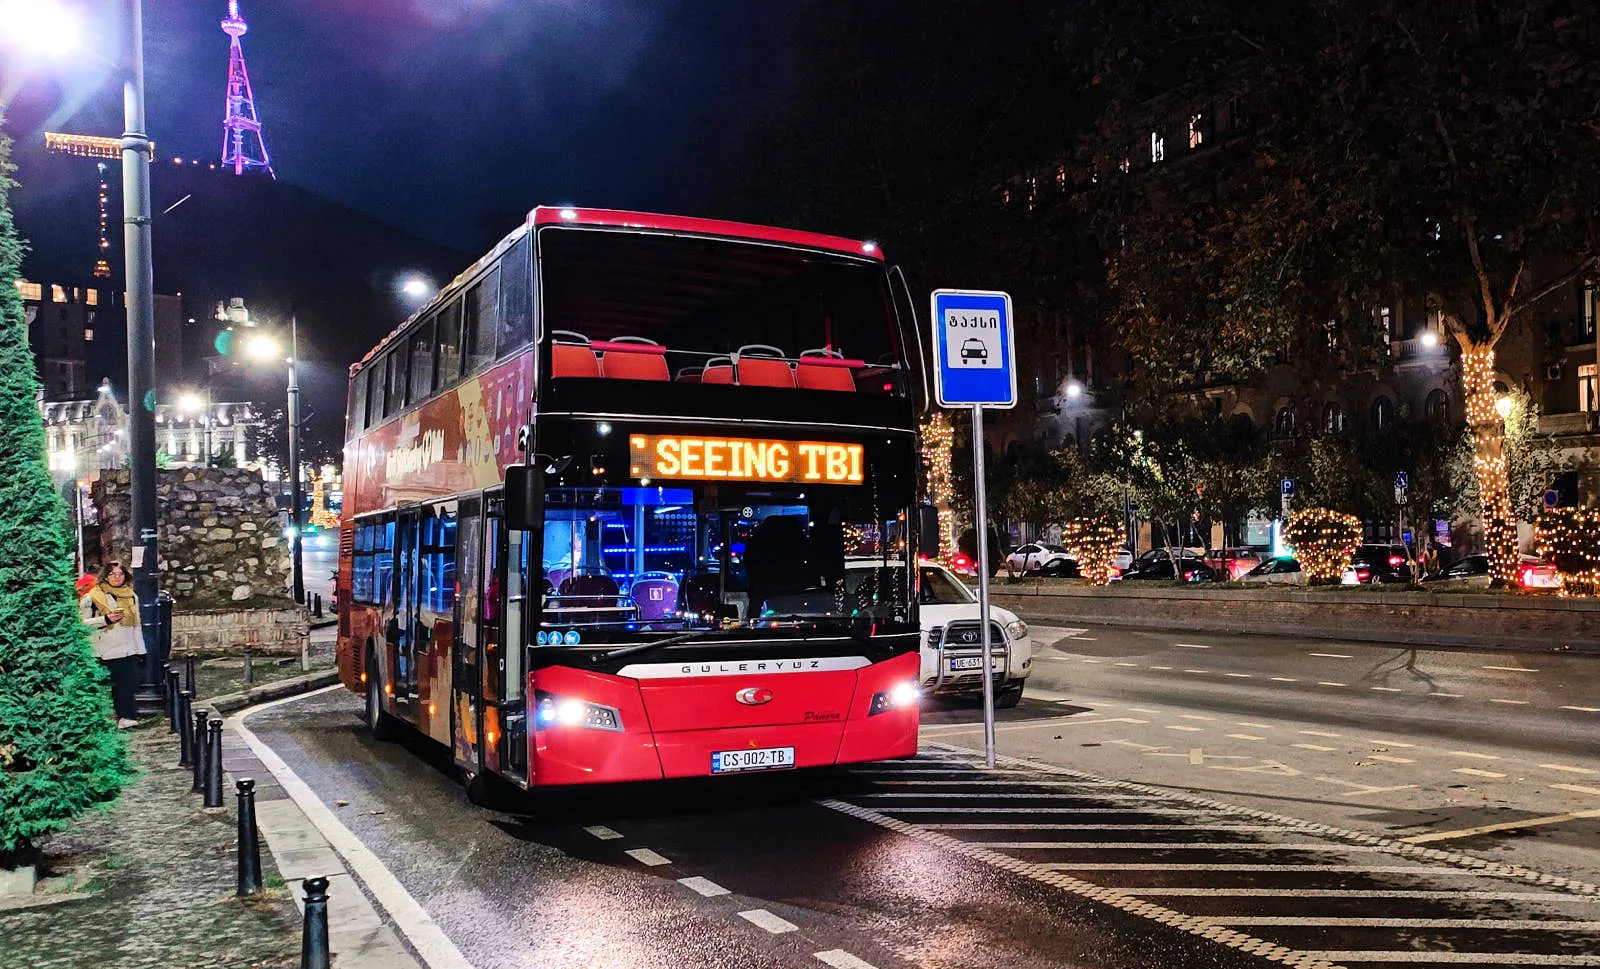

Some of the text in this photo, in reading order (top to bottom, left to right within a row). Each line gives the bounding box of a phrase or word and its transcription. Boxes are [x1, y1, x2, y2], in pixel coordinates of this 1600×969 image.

[949, 315, 997, 329] ტაქსი
[656, 438, 863, 481] SEEING TBI
[956, 658, 996, 668] UE-631
[723, 750, 785, 766] CS-002-TB
